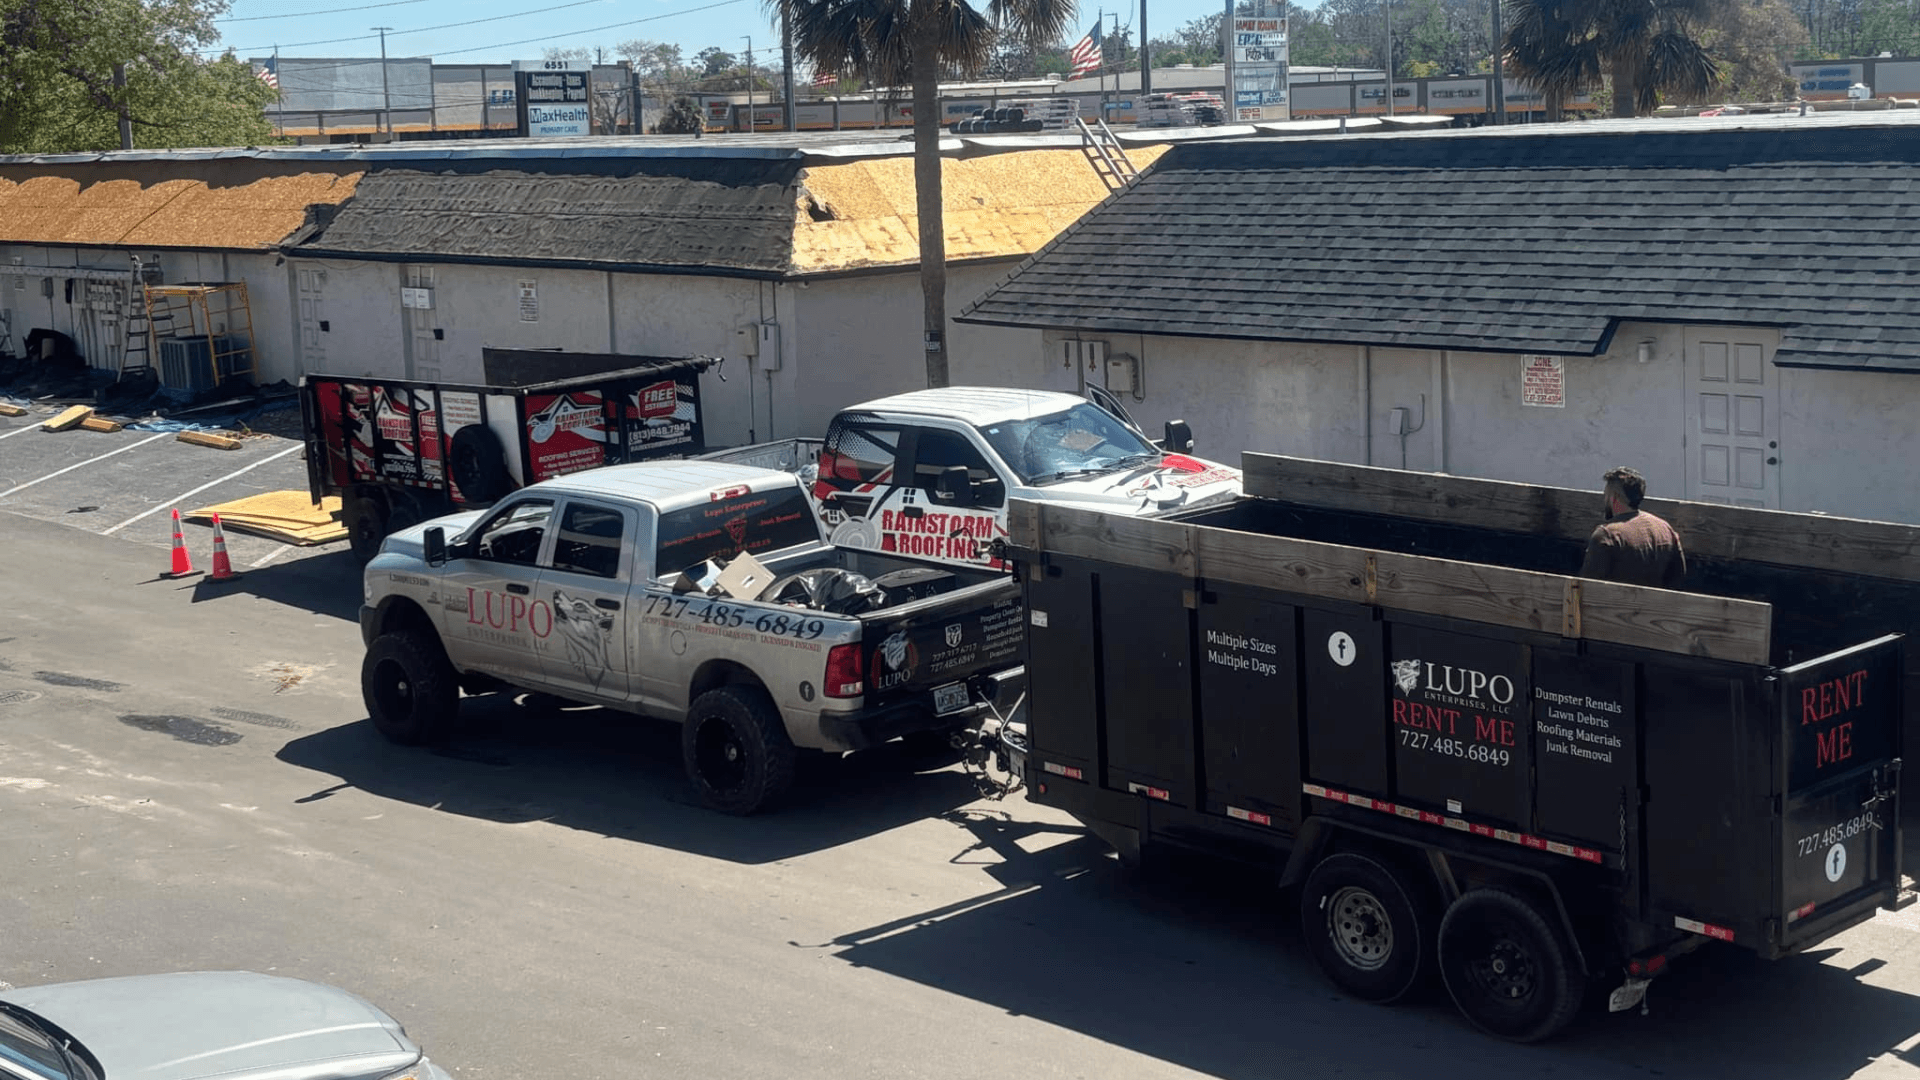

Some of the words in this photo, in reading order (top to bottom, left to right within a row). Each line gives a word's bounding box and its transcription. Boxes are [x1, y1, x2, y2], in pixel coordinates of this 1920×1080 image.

[545, 61, 568, 70] 6551
[530, 108, 588, 123] MaxHealth
[1534, 357, 1552, 367] ZONE
[644, 388, 674, 403] FREE
[882, 509, 993, 538] RAINSTORM
[467, 586, 553, 638] LUPO
[645, 594, 825, 640] 727-485-6849
[1207, 630, 1248, 651] Multiple
[1250, 638, 1276, 655] Sizes
[1208, 650, 1249, 671] Multiple
[1251, 658, 1276, 676] Days
[878, 668, 911, 690] LUPO
[1425, 662, 1515, 704] LUPO
[1424, 691, 1490, 712] ENTERPRISES,
[1492, 704, 1511, 715] LLC
[1535, 687, 1583, 708] Dumpster
[1585, 696, 1622, 714] Rentals
[1801, 670, 1868, 725] RENT
[1393, 698, 1461, 735] RENT
[1475, 714, 1516, 747] ME
[1548, 706, 1575, 722] Lawn
[1576, 711, 1609, 728] Debris
[1400, 729, 1510, 767] 727.485.6849
[1536, 721, 1574, 742] Roofing
[1575, 728, 1622, 748] Materials
[1816, 722, 1853, 769] ME
[1546, 739, 1569, 754] Junk
[1570, 744, 1612, 763] Removal
[1798, 810, 1874, 858] 727.485.6849
